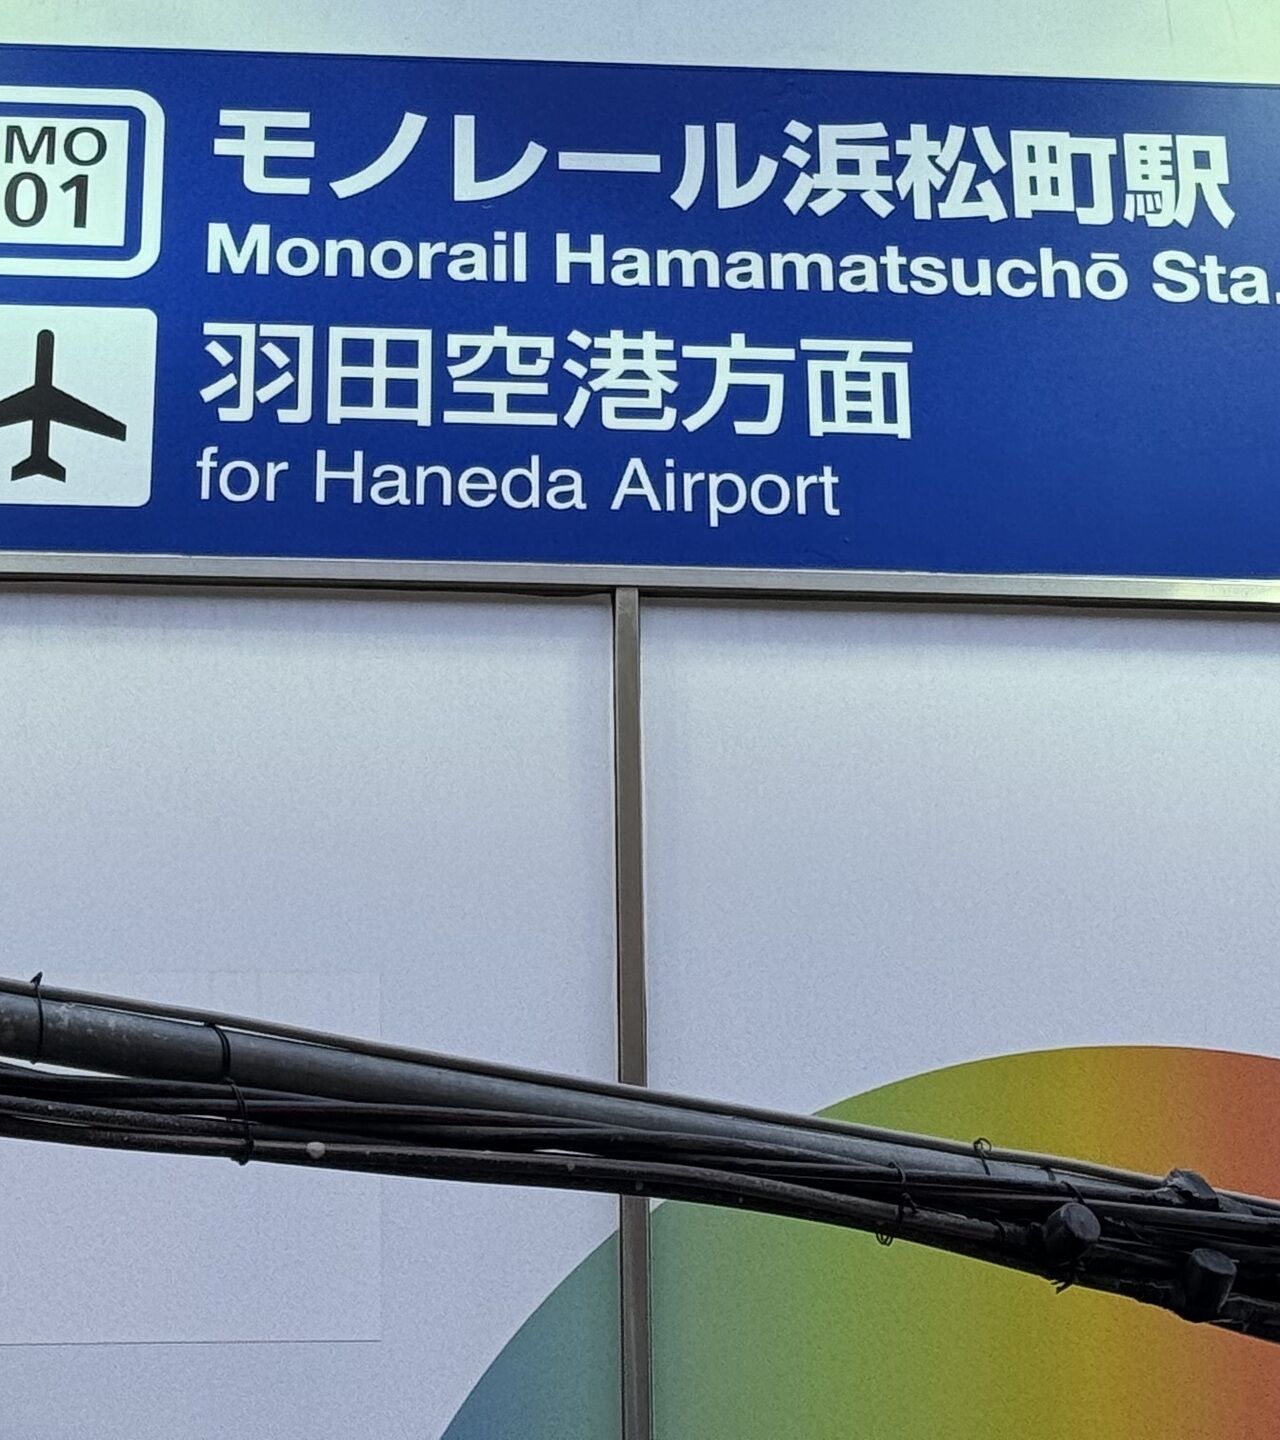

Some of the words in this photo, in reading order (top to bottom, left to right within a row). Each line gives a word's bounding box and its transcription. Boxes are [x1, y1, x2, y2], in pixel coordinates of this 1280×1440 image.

[4, 124, 108, 166] MO
[212, 108, 1236, 230] モノレール浜松町駅
[3, 171, 90, 229] 01
[206, 221, 528, 283] Monorail
[555, 231, 1130, 302] Hamamatsuchō
[198, 321, 914, 440] 羽田空港方面
[196, 446, 289, 502] for
[316, 449, 587, 510] Haneda
[610, 456, 841, 528] Airport
